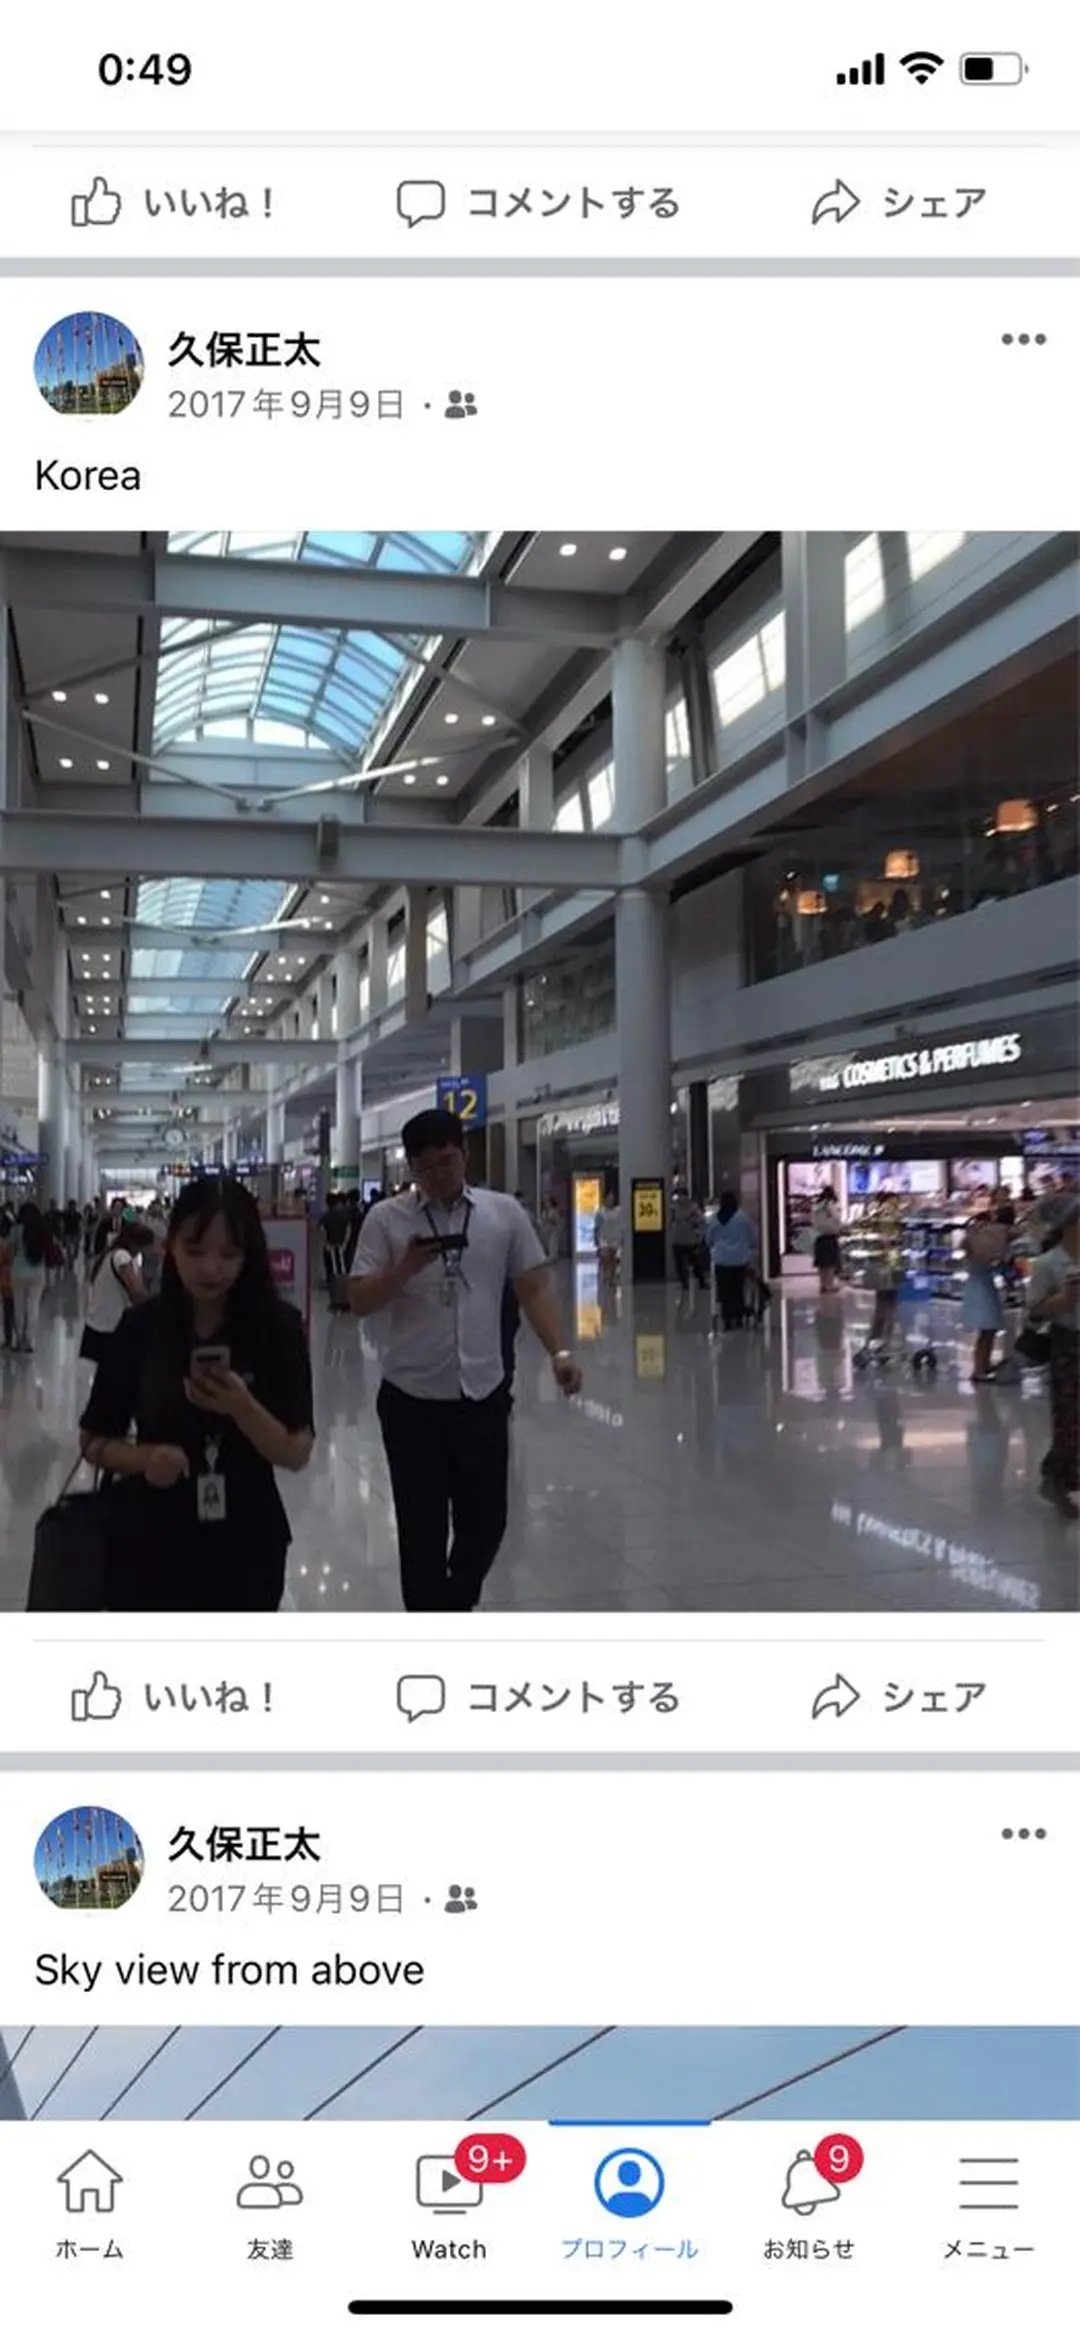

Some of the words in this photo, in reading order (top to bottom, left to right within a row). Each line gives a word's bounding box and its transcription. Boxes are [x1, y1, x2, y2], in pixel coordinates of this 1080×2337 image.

[98, 52, 192, 87] 0:49
[145, 186, 272, 220] いいね！
[469, 186, 680, 220] コメントする
[884, 187, 987, 219] シェア
[167, 330, 322, 369] 久保正太
[36, 459, 141, 491] Korea
[843, 1052, 919, 1088] COSMETICS
[918, 1050, 933, 1076] &
[932, 1033, 1021, 1072] PERFUMES
[443, 1089, 477, 1119] 12
[144, 1680, 272, 1714] いいね！
[469, 1680, 680, 1714] コメントする
[884, 1682, 987, 1713] シェア
[167, 1824, 322, 1863] 久保正太
[35, 1952, 103, 1993] Sky
[114, 1952, 201, 1986] view
[210, 1951, 298, 1986] from
[311, 1952, 425, 1986] above
[468, 2145, 512, 2173] 9+
[829, 2145, 849, 2173] 9
[56, 2238, 124, 2261] ホーム
[247, 2237, 294, 2261] 友達
[410, 2239, 487, 2260] Watch
[563, 2237, 699, 2260] プロフィール
[763, 2238, 855, 2260] お知らせ
[944, 2239, 1035, 2260] メニュー
